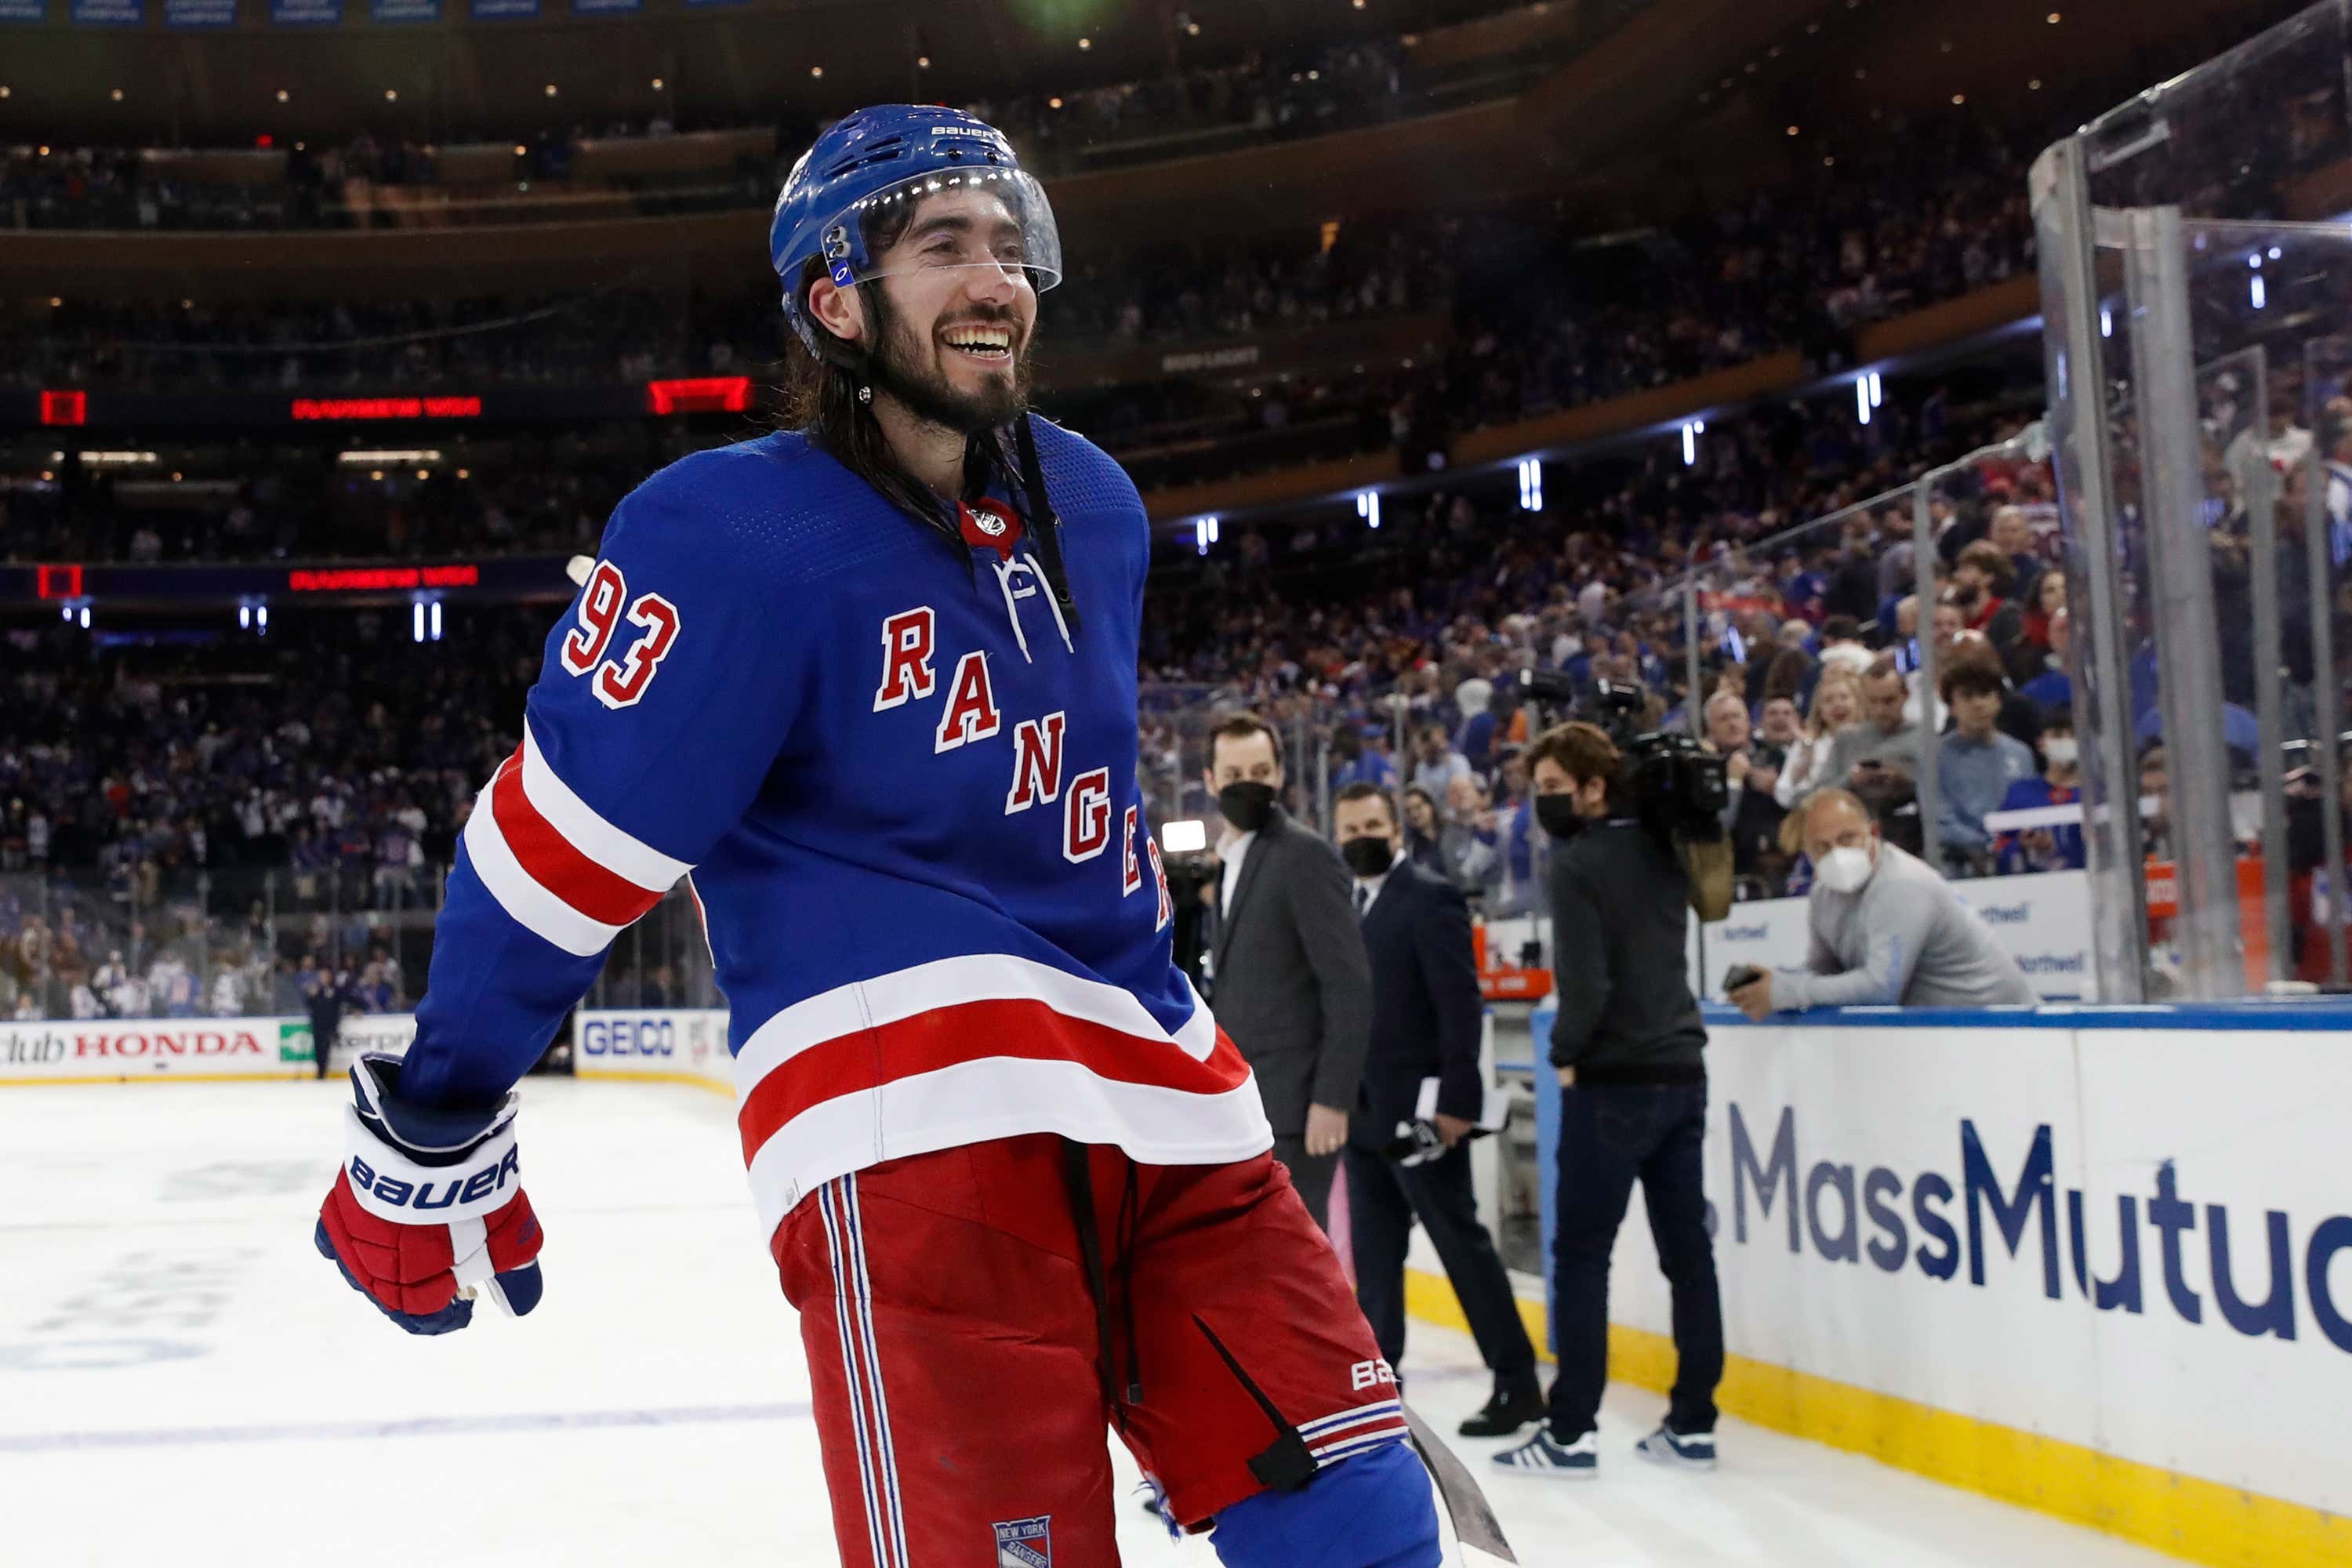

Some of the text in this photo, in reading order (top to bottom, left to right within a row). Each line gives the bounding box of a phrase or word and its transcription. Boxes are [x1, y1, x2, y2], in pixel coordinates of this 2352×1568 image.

[561, 558, 681, 710] 93
[74, 1032, 263, 1058] HONDA
[584, 1020, 676, 1056] GEICO
[350, 1142, 520, 1210] BAUER
[999, 1523, 1046, 1538] NEW YORK
